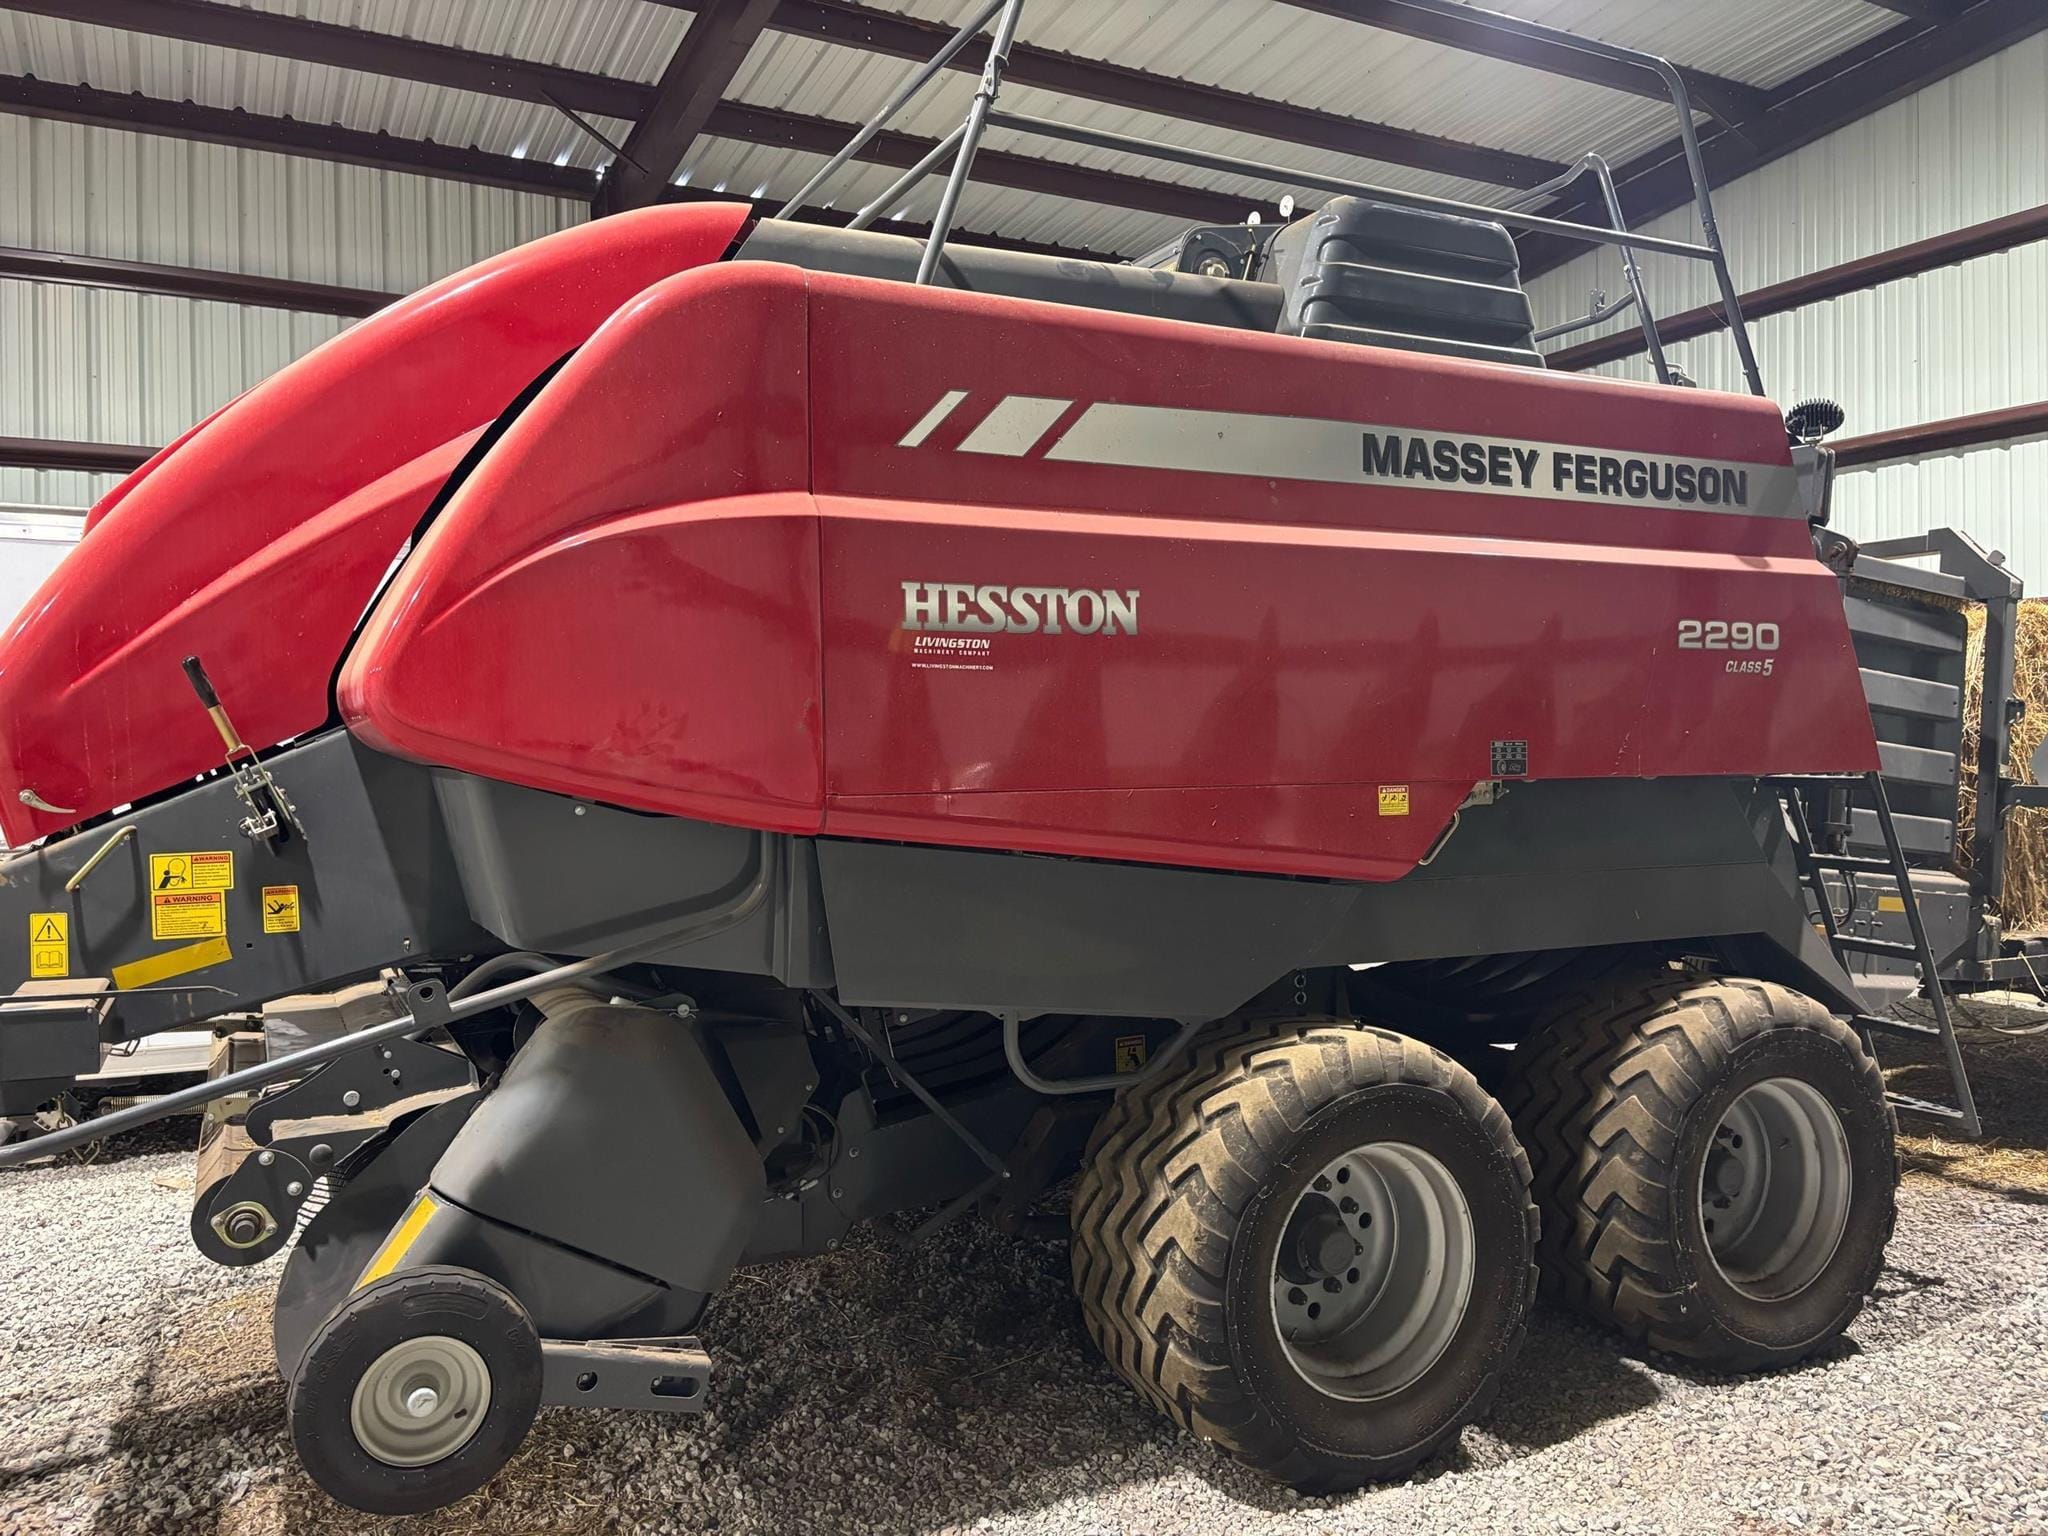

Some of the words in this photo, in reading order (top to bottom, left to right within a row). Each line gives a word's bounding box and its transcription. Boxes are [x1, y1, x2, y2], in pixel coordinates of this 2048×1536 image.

[1362, 433, 1539, 488] MASSEY
[1552, 452, 1748, 505] FERGUSON
[901, 582, 1140, 635] HESSTON
[914, 636, 990, 649] LIVINGSTON
[1678, 620, 1779, 650] 2290
[1725, 660, 1761, 673] CLASS
[1762, 659, 1774, 676] 5
[172, 894, 213, 903] WARNING
